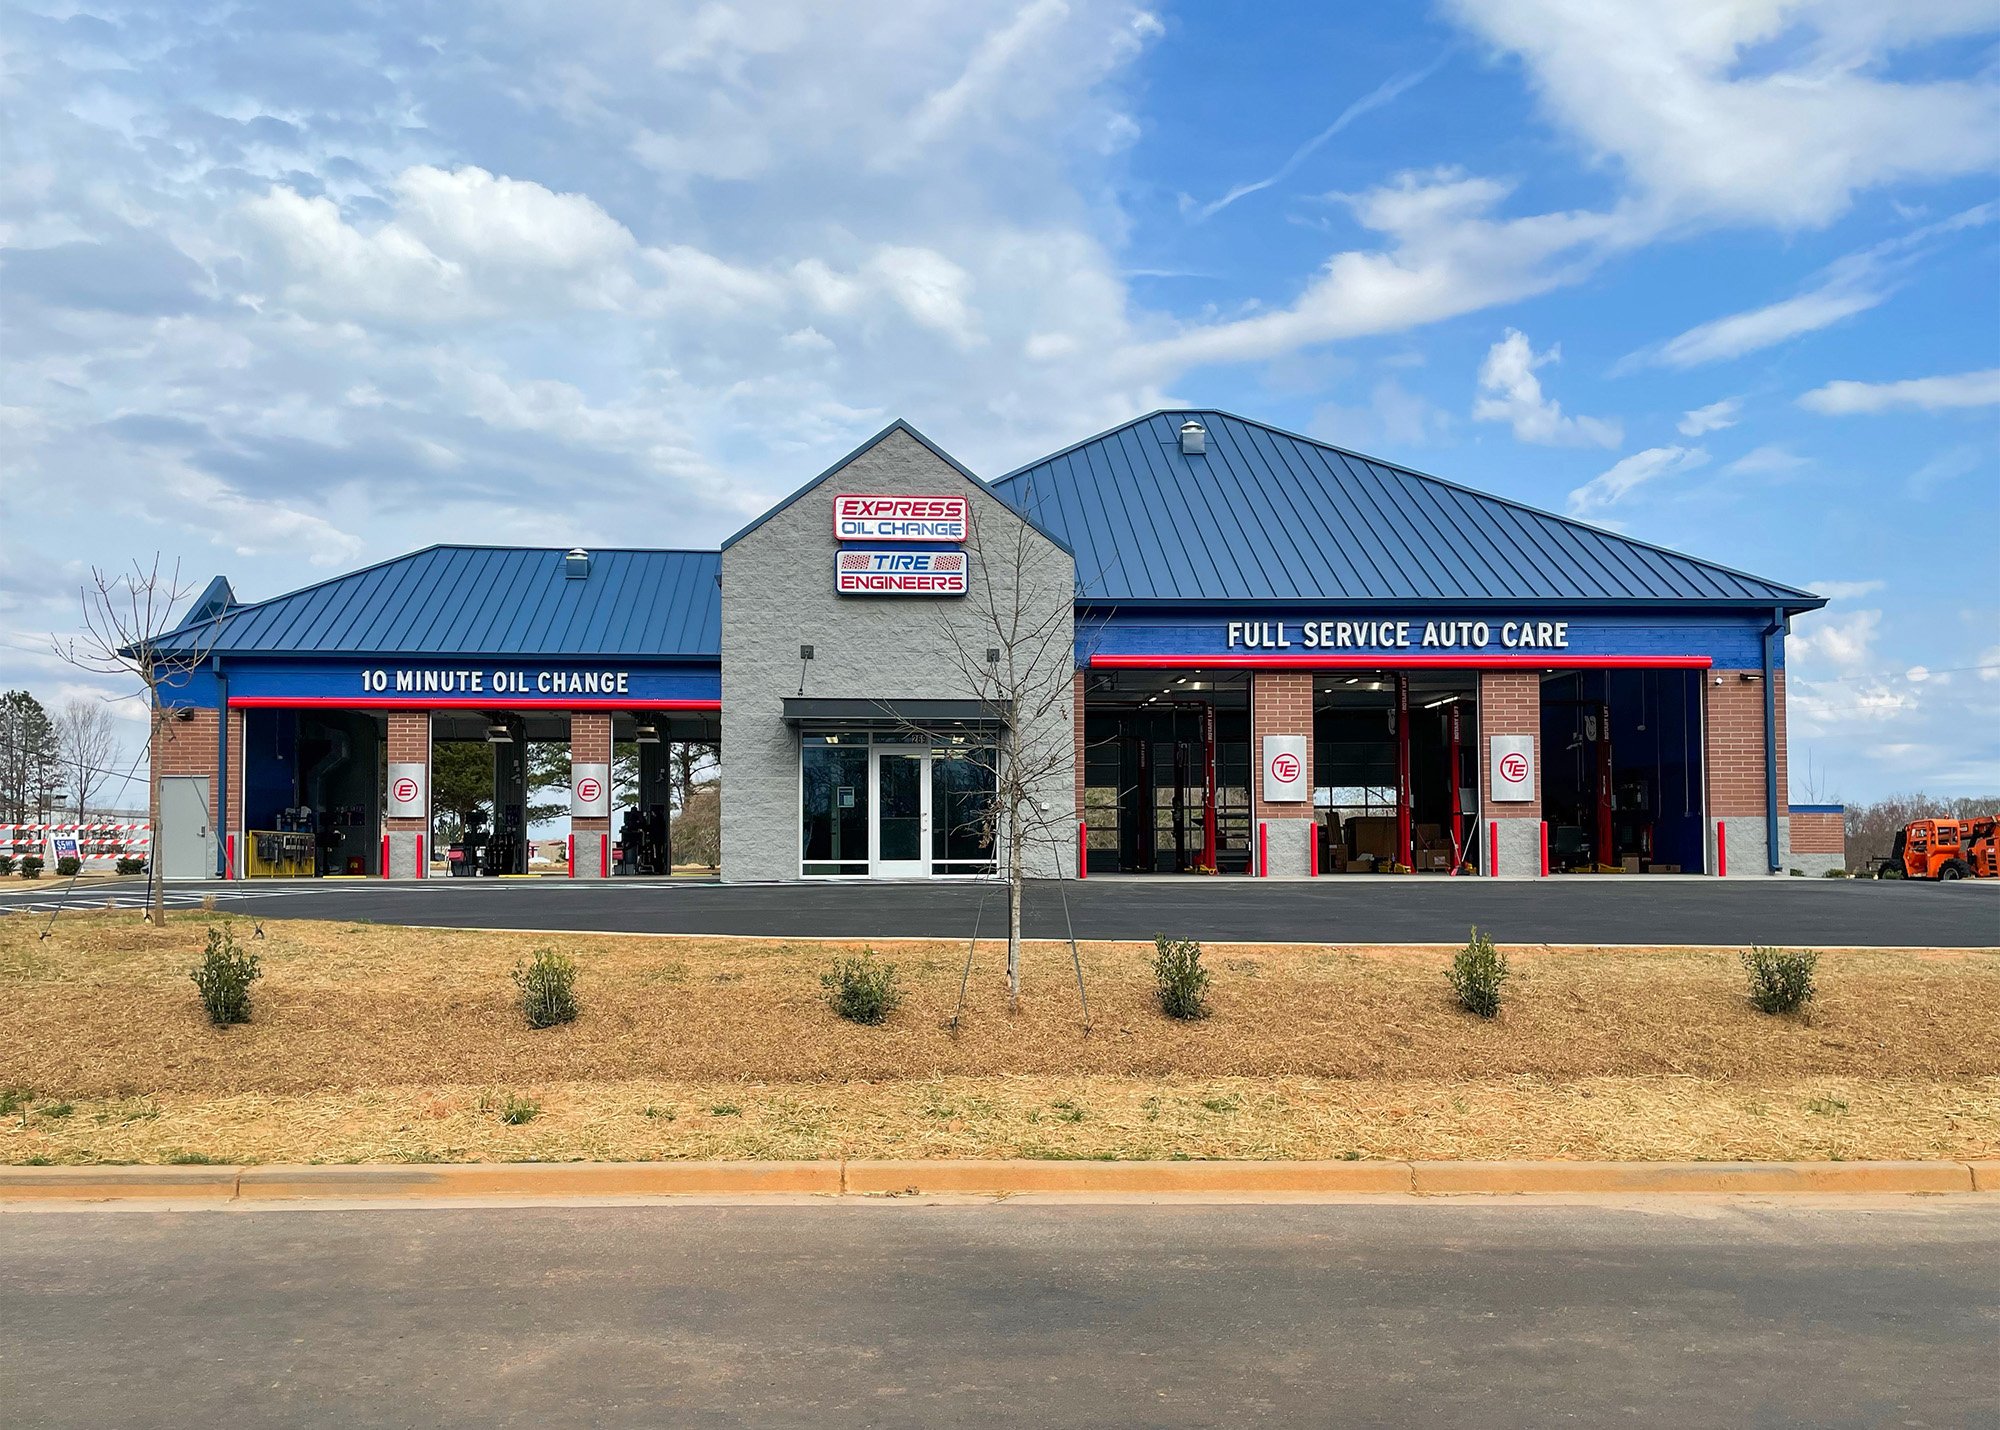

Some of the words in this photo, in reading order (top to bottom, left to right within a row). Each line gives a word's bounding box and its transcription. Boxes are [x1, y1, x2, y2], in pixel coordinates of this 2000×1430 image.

[842, 500, 963, 517] EXPRESS
[841, 521, 874, 535] OIL
[878, 522, 962, 536] CHANGE
[874, 555, 931, 571] TIRE
[841, 576, 963, 590] ENGINEERS
[1228, 621, 1291, 648] FULL
[1303, 621, 1410, 648] SERVICE
[1422, 621, 1490, 648] AUTO
[1502, 622, 1569, 648] CARE
[361, 670, 388, 692] 10
[396, 670, 483, 692] MINUTE
[492, 671, 530, 693] OIL
[537, 672, 629, 693] CHANGE
[1276, 761, 1297, 777] TE
[1505, 760, 1526, 777] TE
[398, 784, 413, 796] E
[582, 784, 597, 796] E
